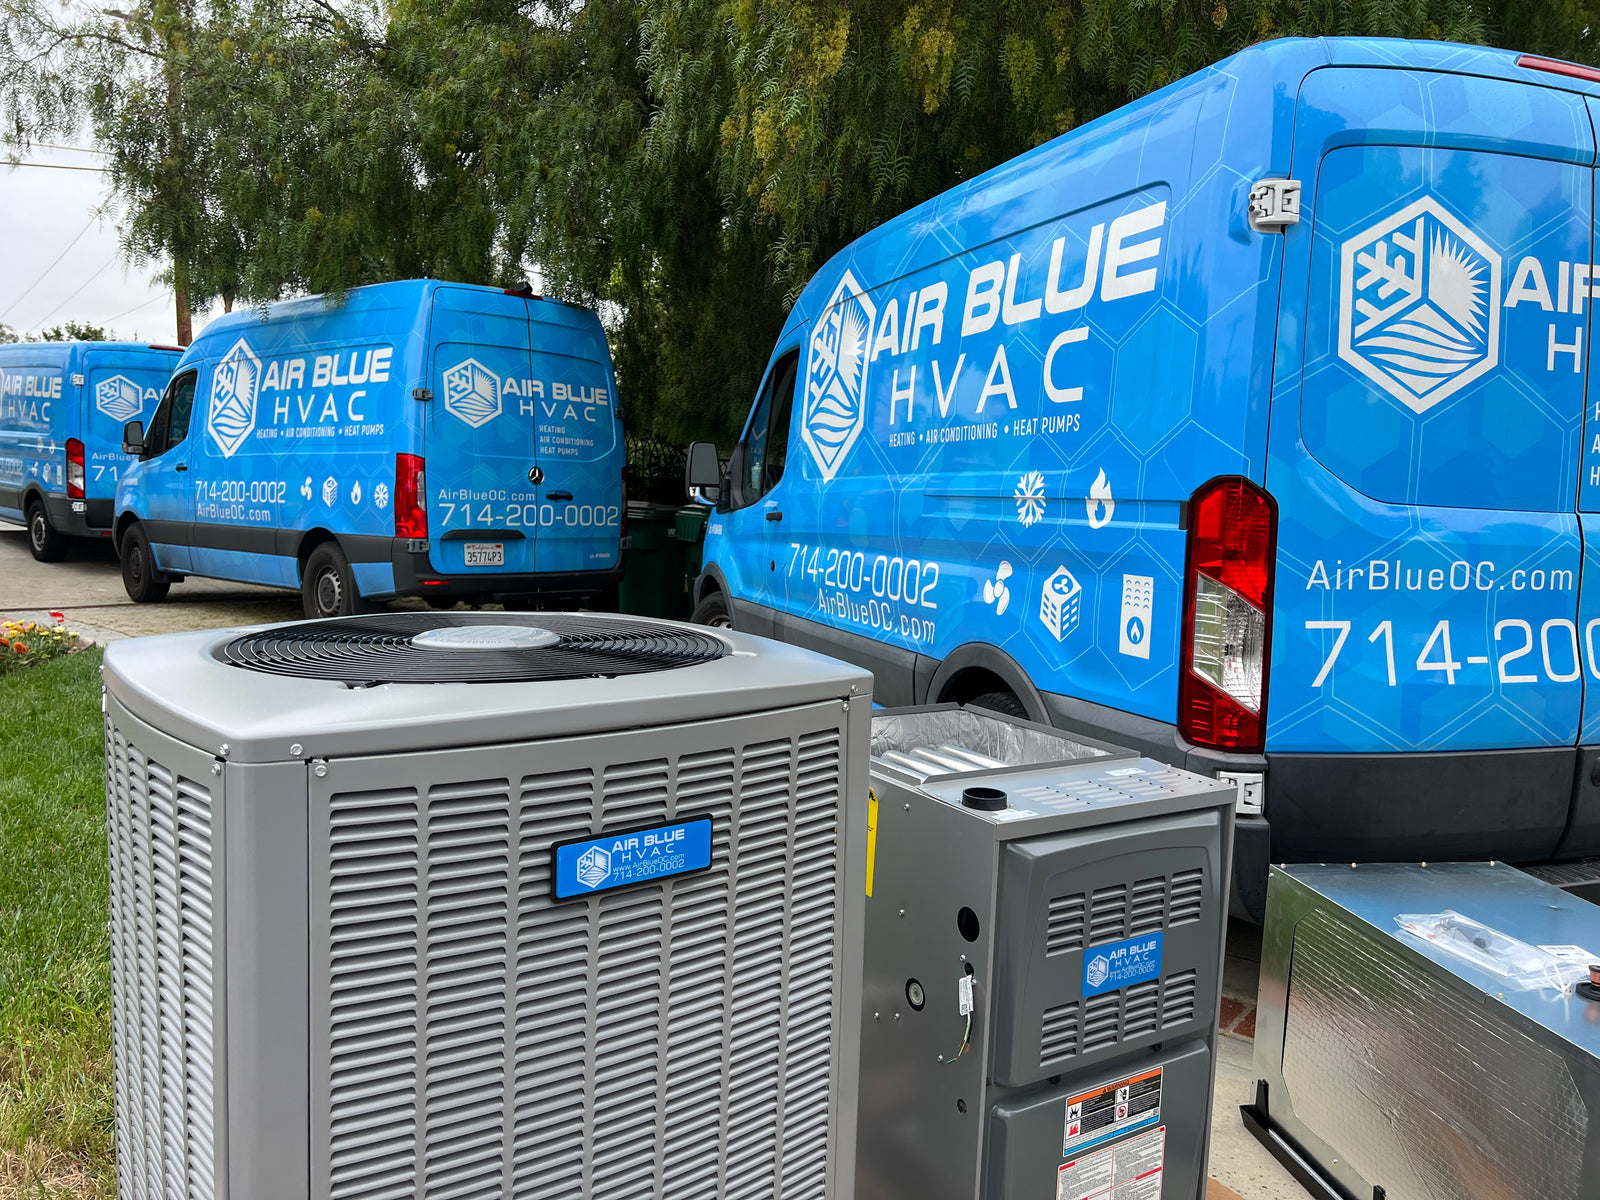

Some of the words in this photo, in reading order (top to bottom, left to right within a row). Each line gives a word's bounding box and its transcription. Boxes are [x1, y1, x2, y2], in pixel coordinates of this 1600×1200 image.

[870, 281, 948, 362] AIR
[961, 200, 1167, 337] BLUE
[261, 358, 306, 392] AIR
[312, 347, 393, 388] BLUE
[889, 326, 1090, 425] HVAC
[4, 374, 23, 396] AIR
[25, 375, 63, 399] BLUE
[502, 377, 545, 399] AIR
[552, 382, 608, 406] BLUE
[273, 390, 366, 425] HVAC
[520, 400, 596, 422] HVAC
[256, 428, 278, 439] HEATING
[285, 427, 295, 438] AIR
[344, 425, 360, 437] HEAT
[361, 424, 384, 436] PUMPS
[539, 424, 566, 434] HEATING
[540, 435, 550, 443] AIR
[551, 437, 594, 447] CONDITIONING
[889, 431, 916, 448] HEATING
[926, 428, 939, 444] AIR
[940, 422, 998, 442] CONDITIONING
[1013, 418, 1039, 437] HEAT
[1042, 413, 1081, 434] PUMPS
[540, 446, 556, 454] HEAT
[557, 447, 579, 456] PUMPS
[195, 480, 286, 504] 714-200-0002
[438, 489, 535, 502] AirBlueOC.com
[197, 503, 271, 521] AirBlueOC.com
[438, 503, 619, 527] 714-200-0002
[788, 543, 940, 609] 714-200-0002
[1305, 559, 1574, 592] AirBlueOC.com
[818, 588, 936, 645] AirBlueOC.com
[611, 837, 639, 853] AIR
[644, 828, 685, 847] BLUE
[621, 842, 675, 863] HVAC
[613, 858, 685, 882] 714-200-0002
[1109, 948, 1127, 961] AIR
[1129, 940, 1157, 955] BLUE
